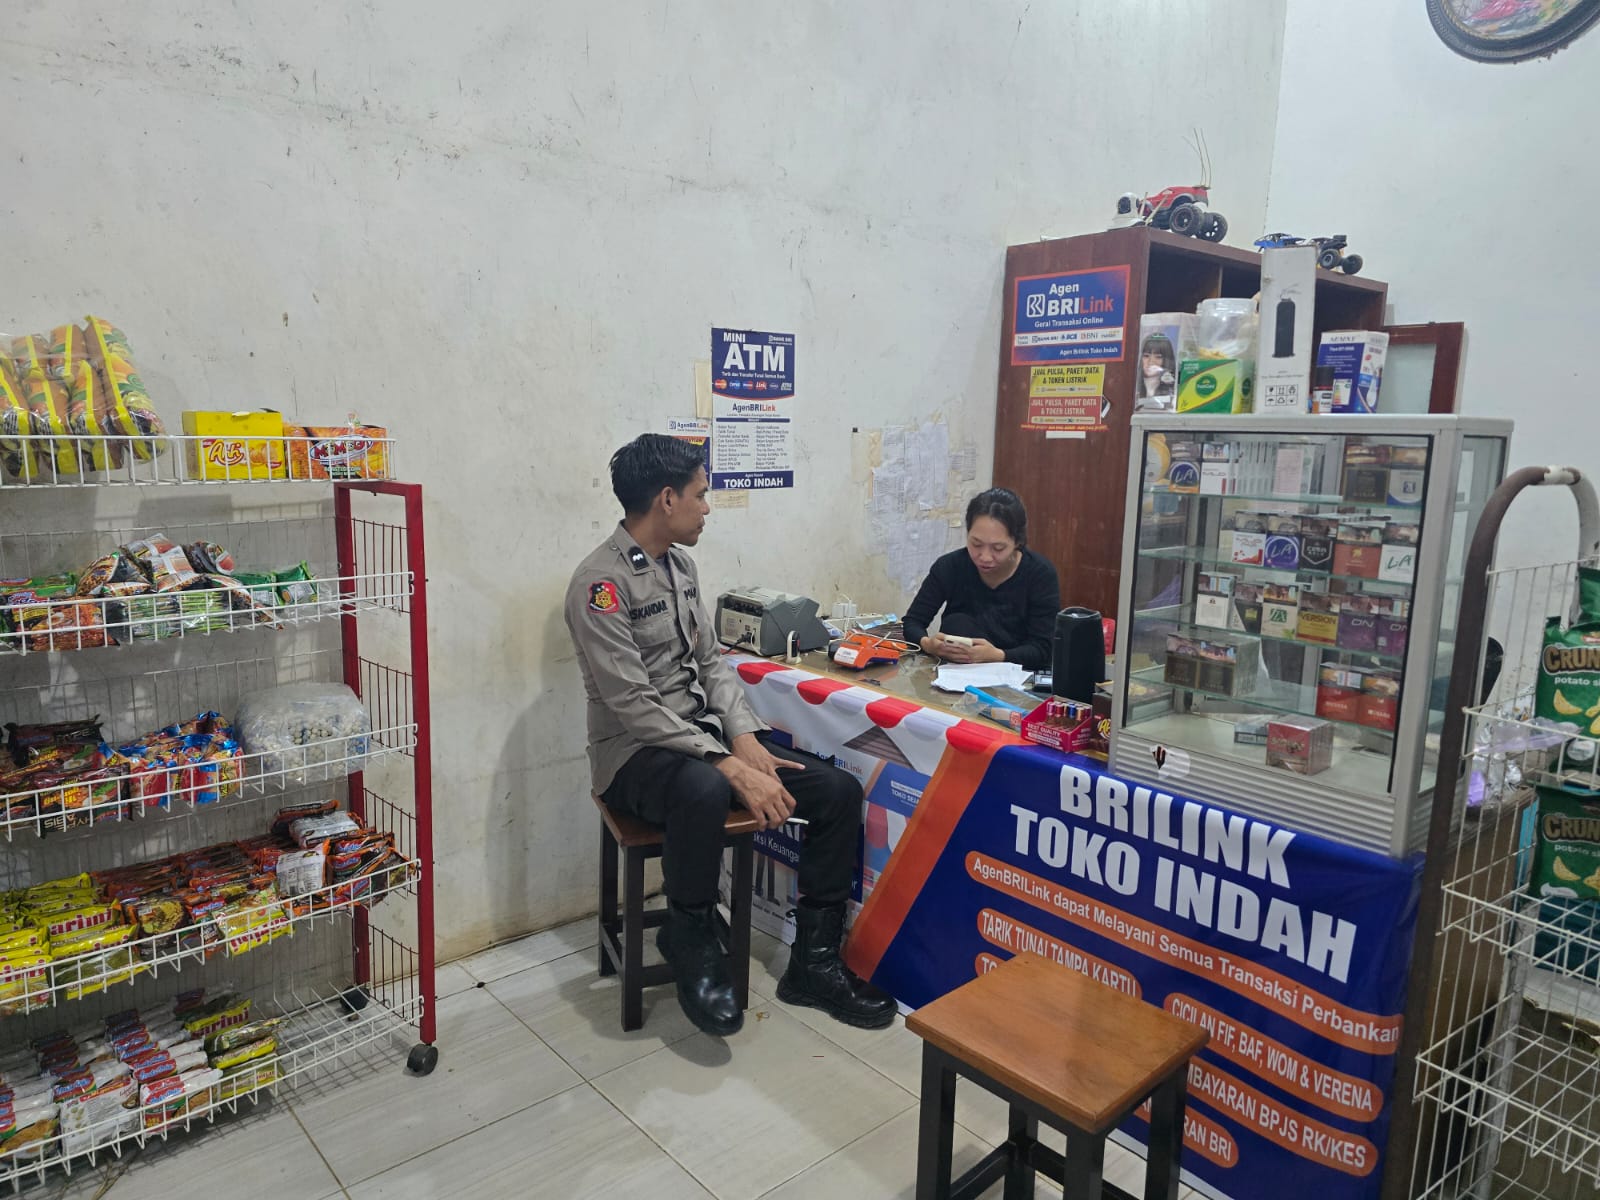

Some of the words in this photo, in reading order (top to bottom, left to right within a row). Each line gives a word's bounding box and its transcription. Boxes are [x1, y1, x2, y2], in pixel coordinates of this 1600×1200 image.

[1049, 283, 1079, 297] Agen
[1047, 294, 1114, 317] BRILink
[723, 332, 746, 343] MINI
[723, 343, 785, 372] ATM
[1066, 367, 1083, 375] PAKET
[1066, 376, 1087, 384] LISTRIK
[732, 403, 776, 412] AgenBRILink
[723, 478, 751, 489] TOKO
[754, 477, 784, 488] INDAH
[1271, 543, 1292, 558] LA
[1387, 554, 1413, 570] LA
[1300, 613, 1337, 625] VERSION
[1554, 676, 1590, 686] potato
[1027, 722, 1040, 730] BEST
[1040, 726, 1061, 738] QUALITY
[1060, 764, 1296, 889] BRILINK
[768, 836, 800, 863] Keuanga
[1010, 804, 1140, 896] TOKO
[1154, 855, 1357, 984] INDAH
[51, 907, 113, 936] arimi
[973, 857, 1051, 903] AgenBRILink
[1053, 891, 1090, 919] dapat
[1093, 906, 1156, 948] Melayani
[1158, 934, 1214, 971] Semua
[1218, 956, 1298, 1009] Transaksi
[1301, 994, 1400, 1044] Perbankan
[982, 911, 1013, 947] TARIK
[1015, 926, 1049, 957] TUNAI
[1051, 943, 1090, 976] TAMPA
[1217, 1020, 1236, 1054] FIF,
[1238, 1031, 1264, 1069] BAF,
[1266, 1046, 1298, 1084] WOM
[1299, 1064, 1310, 1089] &
[1313, 1069, 1374, 1112] VERENA
[1187, 1063, 1257, 1121] MBAYARAN
[1259, 1103, 1299, 1142] BPJS
[1301, 1121, 1368, 1169] RK/KES
[1209, 1130, 1232, 1162] BRI
